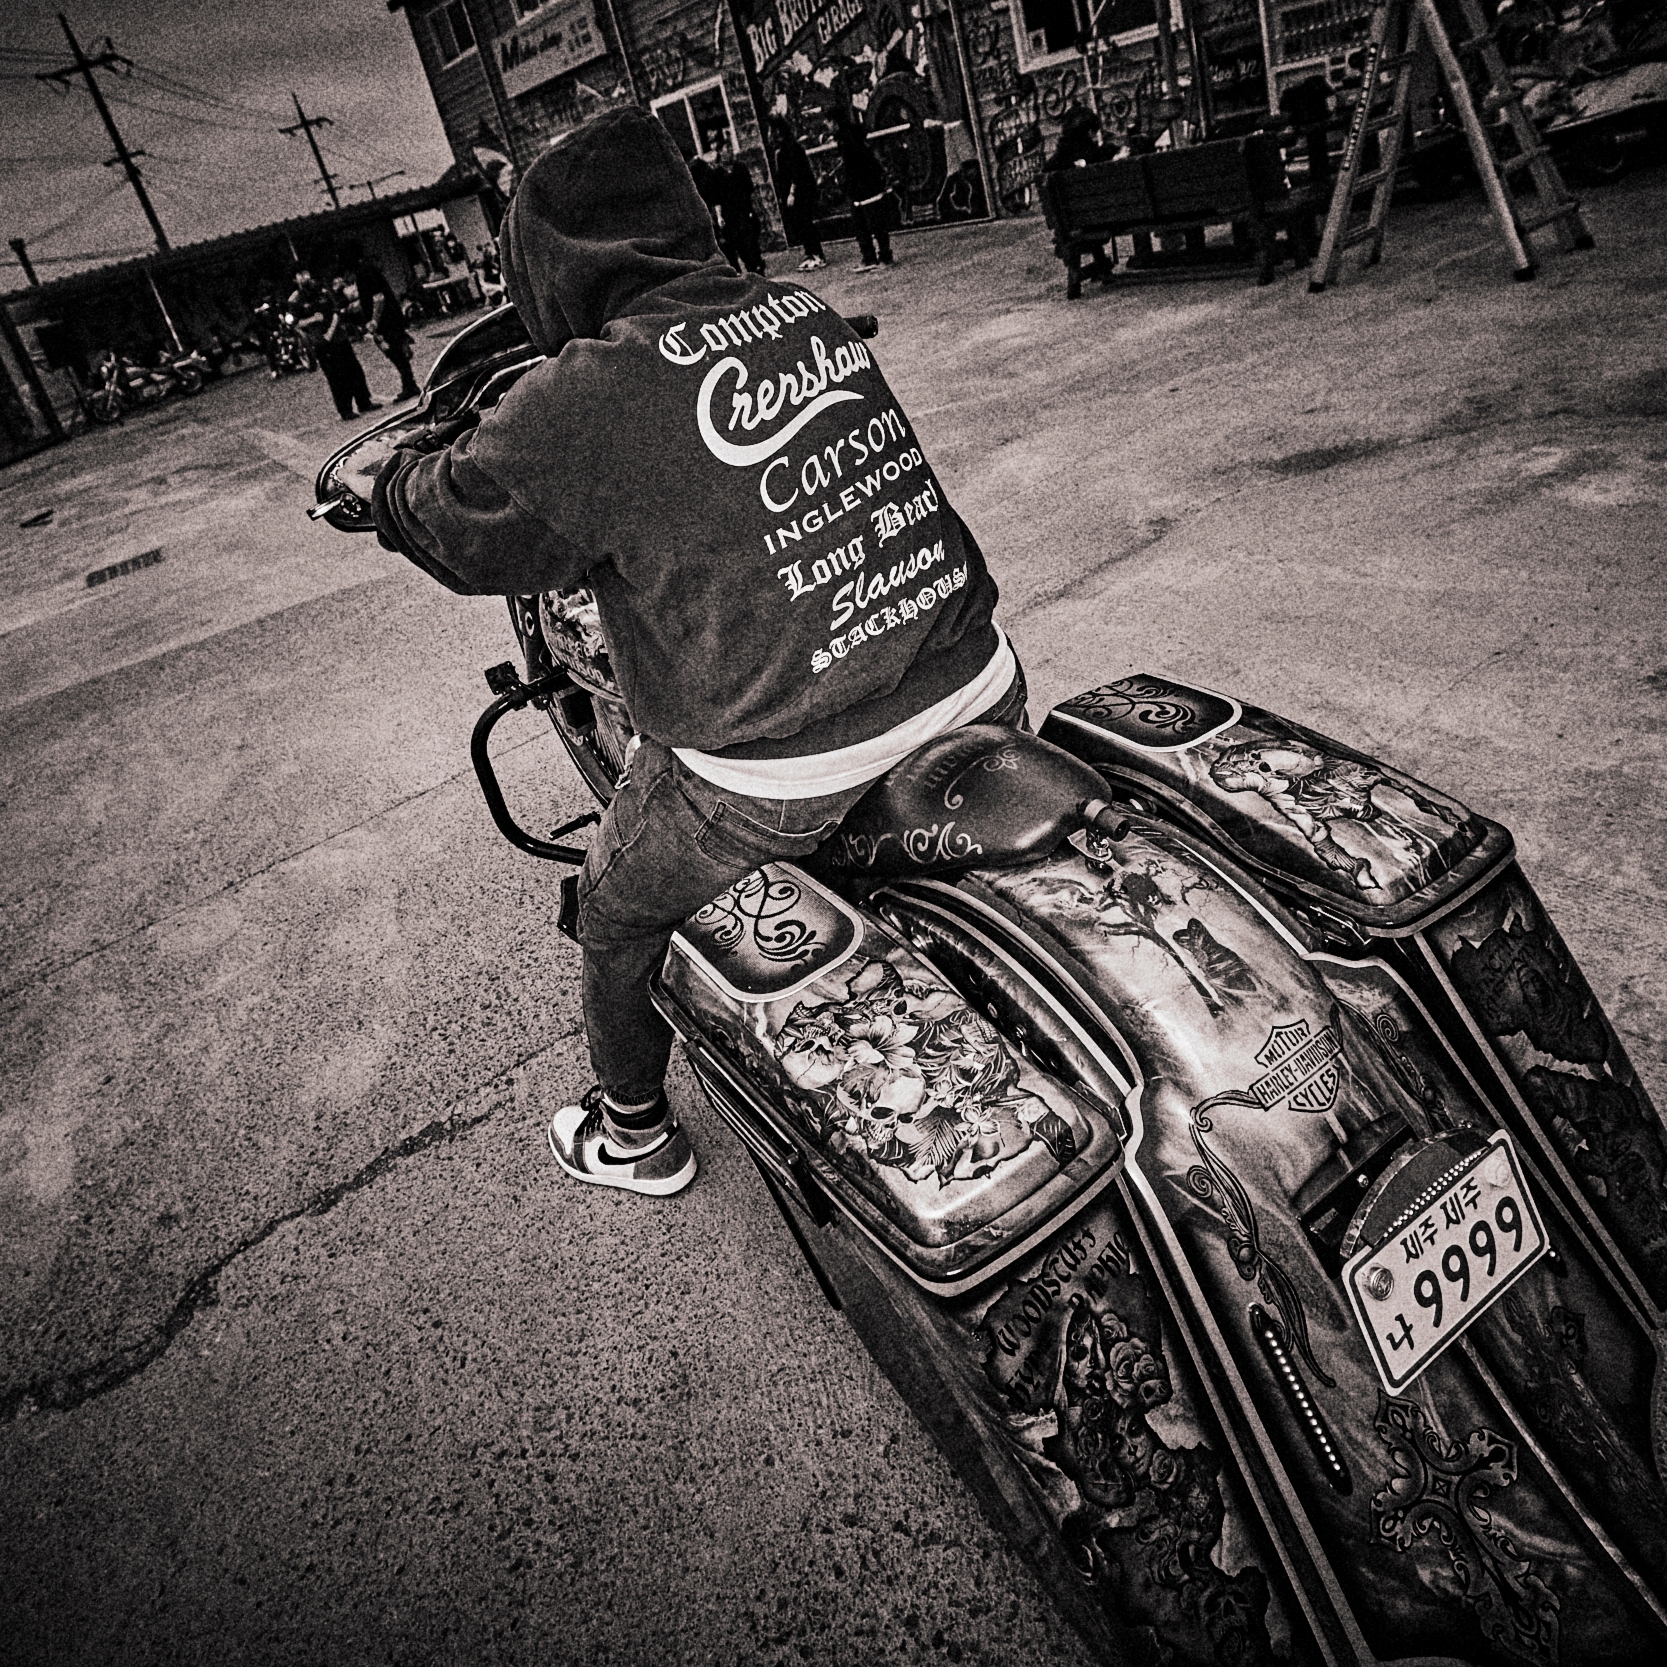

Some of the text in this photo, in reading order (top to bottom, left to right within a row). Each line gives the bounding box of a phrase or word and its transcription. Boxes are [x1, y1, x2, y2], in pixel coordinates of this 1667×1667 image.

[746, 23, 778, 73] BIG
[658, 290, 827, 365] Compton
[696, 336, 870, 467] Crenshaw
[760, 408, 906, 512] Carson
[764, 447, 923, 555] INGLEWOOD
[777, 535, 866, 602] Long
[829, 538, 945, 631] Slauson
[810, 560, 968, 674] STACKHOUS
[1255, 1031, 1339, 1104] HARLEY-DAVIDSON
[1263, 1027, 1308, 1066] MOTOR
[1292, 1067, 1337, 1108] CYCLES
[1399, 1176, 1482, 1264] 제주 제주
[1413, 1195, 1523, 1329] 9999
